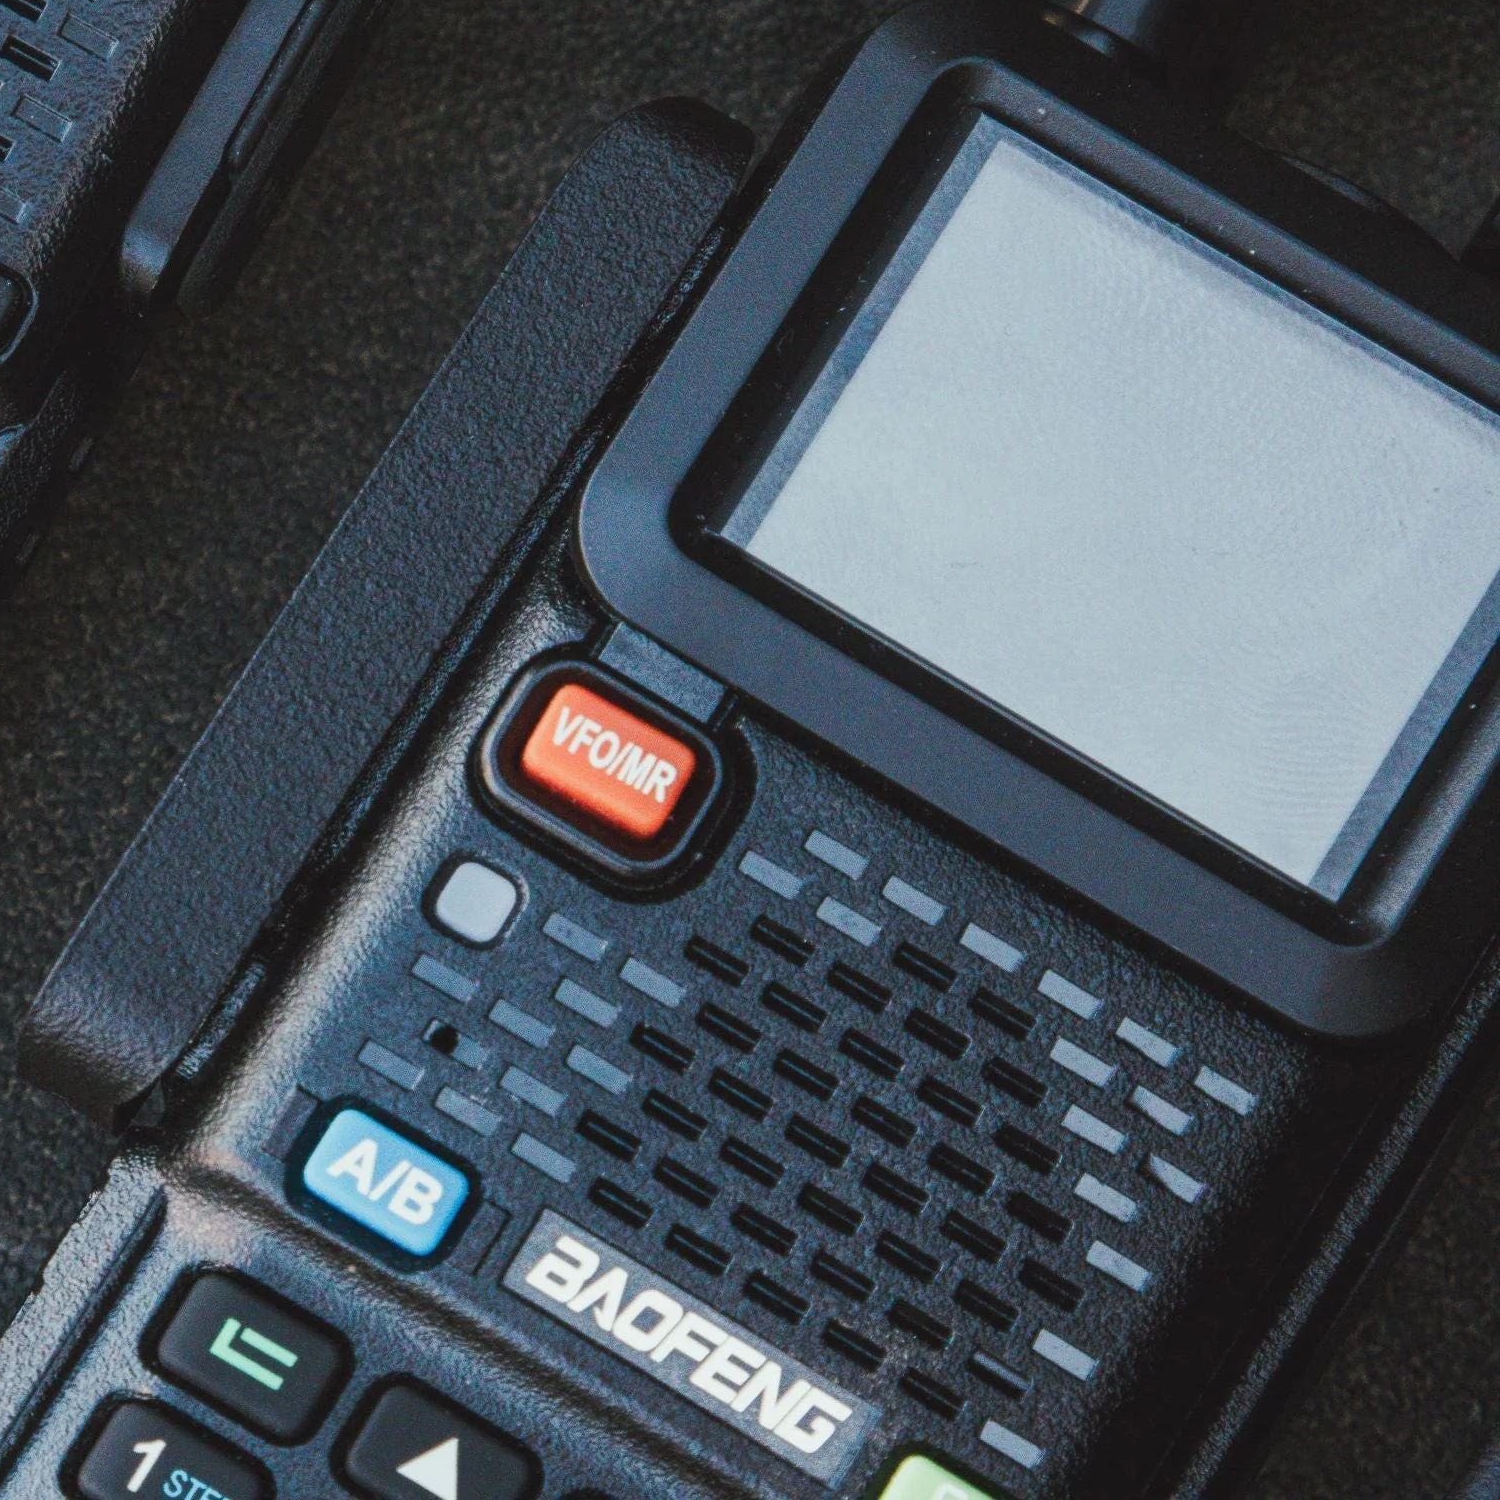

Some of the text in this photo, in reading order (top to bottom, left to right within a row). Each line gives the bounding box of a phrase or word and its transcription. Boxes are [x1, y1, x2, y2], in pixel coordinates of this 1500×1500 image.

[551, 706, 677, 803] VFO/MR
[326, 1138, 444, 1226] A/B
[524, 1234, 854, 1455] BAOFENG
[127, 1439, 167, 1493] 1
